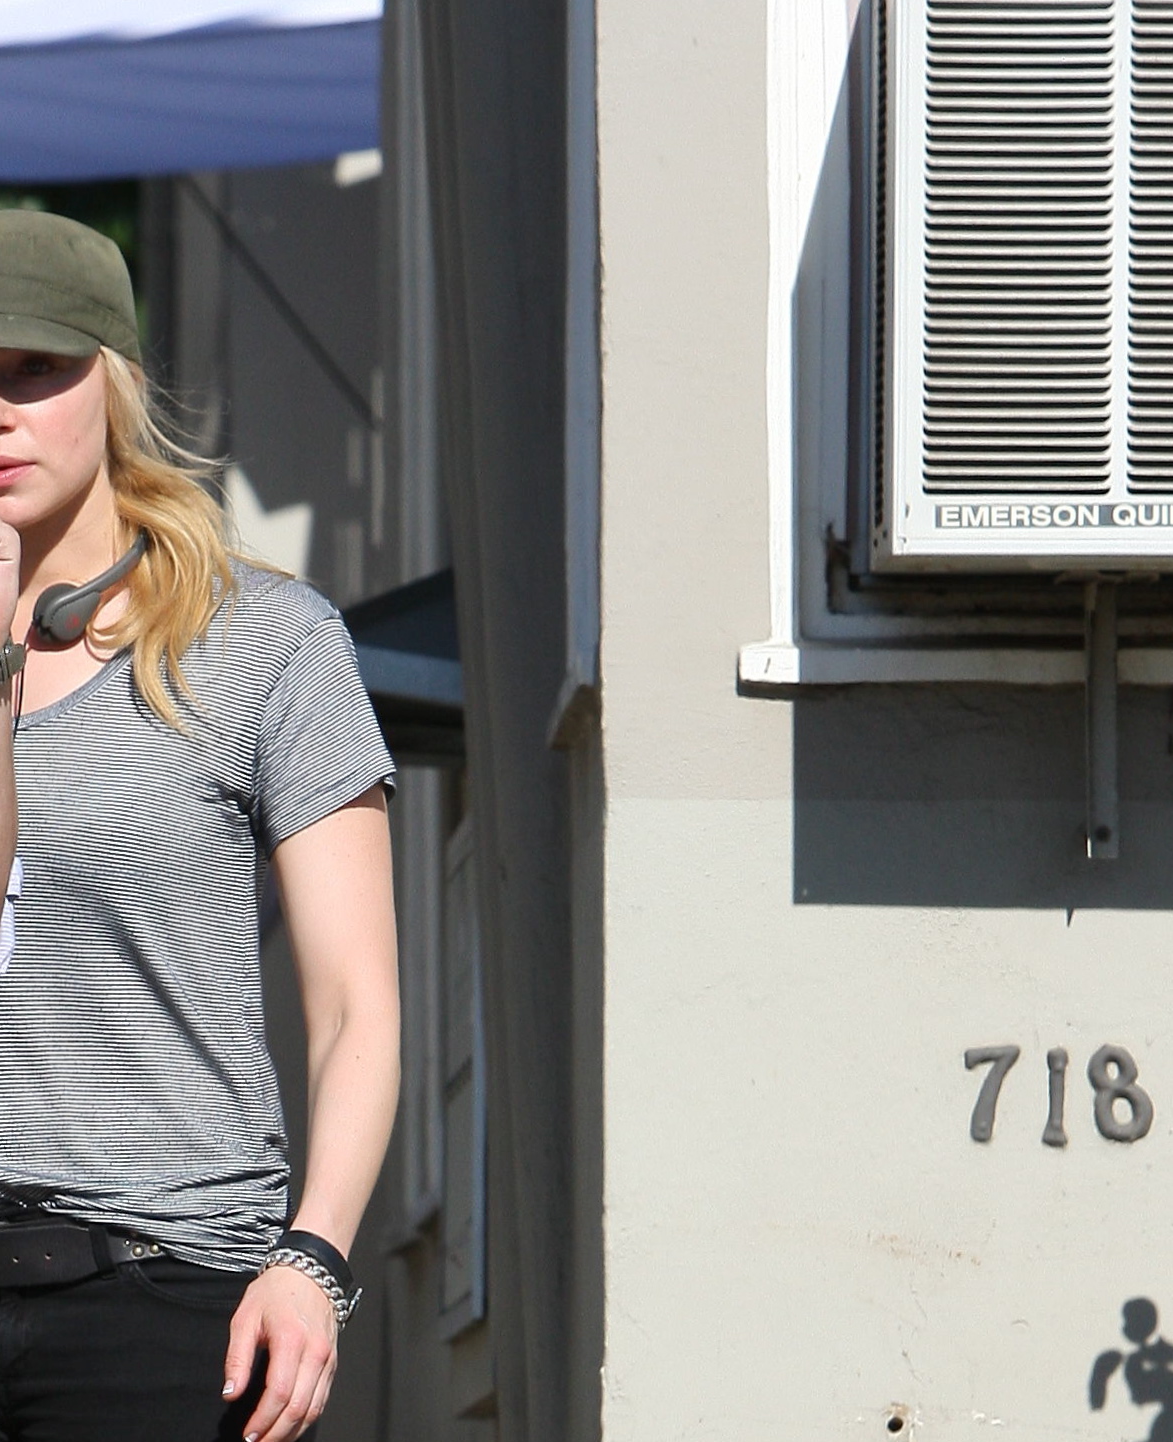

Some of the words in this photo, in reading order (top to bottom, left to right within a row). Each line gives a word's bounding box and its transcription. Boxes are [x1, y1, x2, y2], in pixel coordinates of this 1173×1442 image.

[940, 504, 1100, 527] EMERSON
[1112, 504, 1173, 527] QUI
[964, 1044, 1154, 1147] 718
